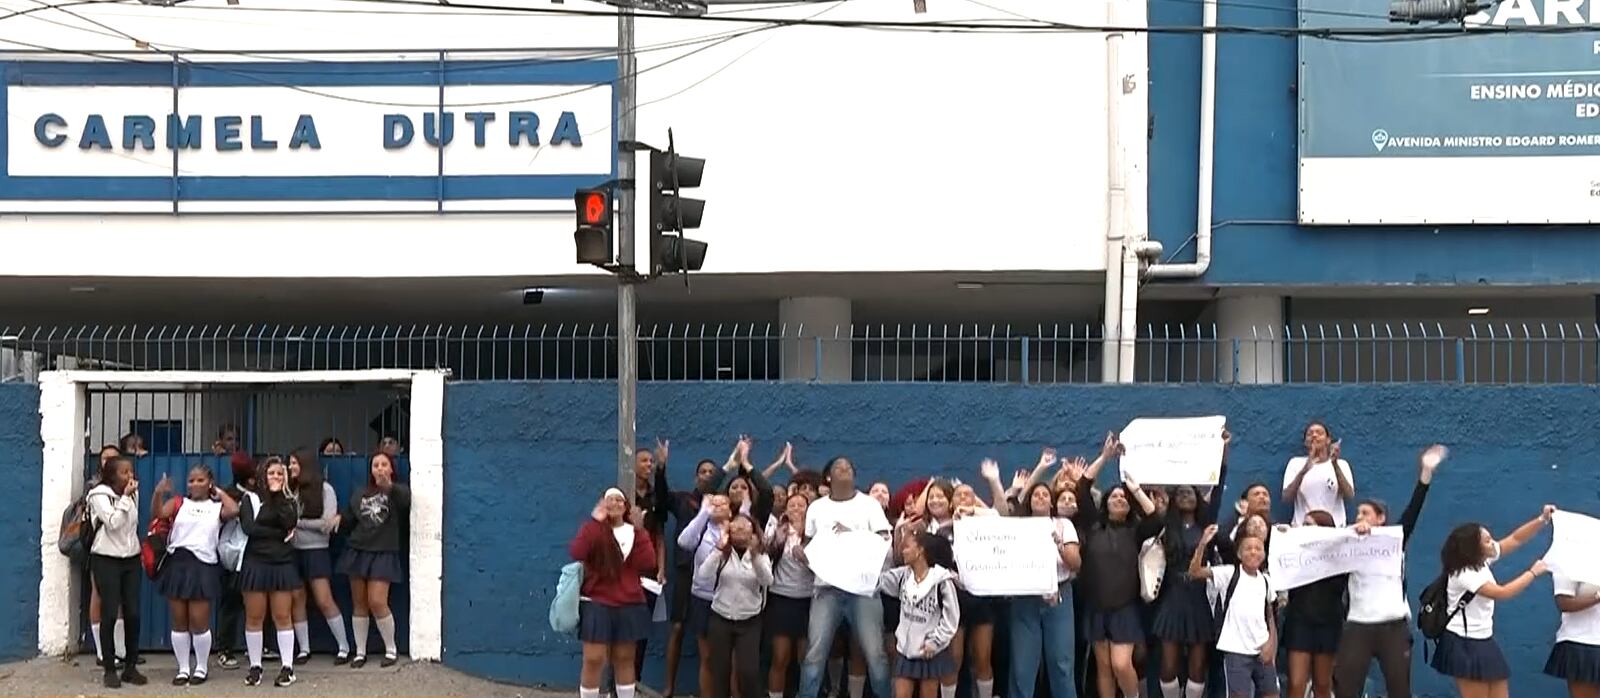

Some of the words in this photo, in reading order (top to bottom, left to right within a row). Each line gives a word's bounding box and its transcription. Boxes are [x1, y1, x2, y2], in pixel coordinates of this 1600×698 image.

[1470, 84, 1541, 100] ENSINO
[34, 113, 322, 151] CARMELA
[383, 111, 583, 150] DUTRA
[1388, 137, 1440, 147] AVENIDA
[1443, 136, 1502, 147] MINISTRO
[1505, 136, 1556, 146] EDGARD
